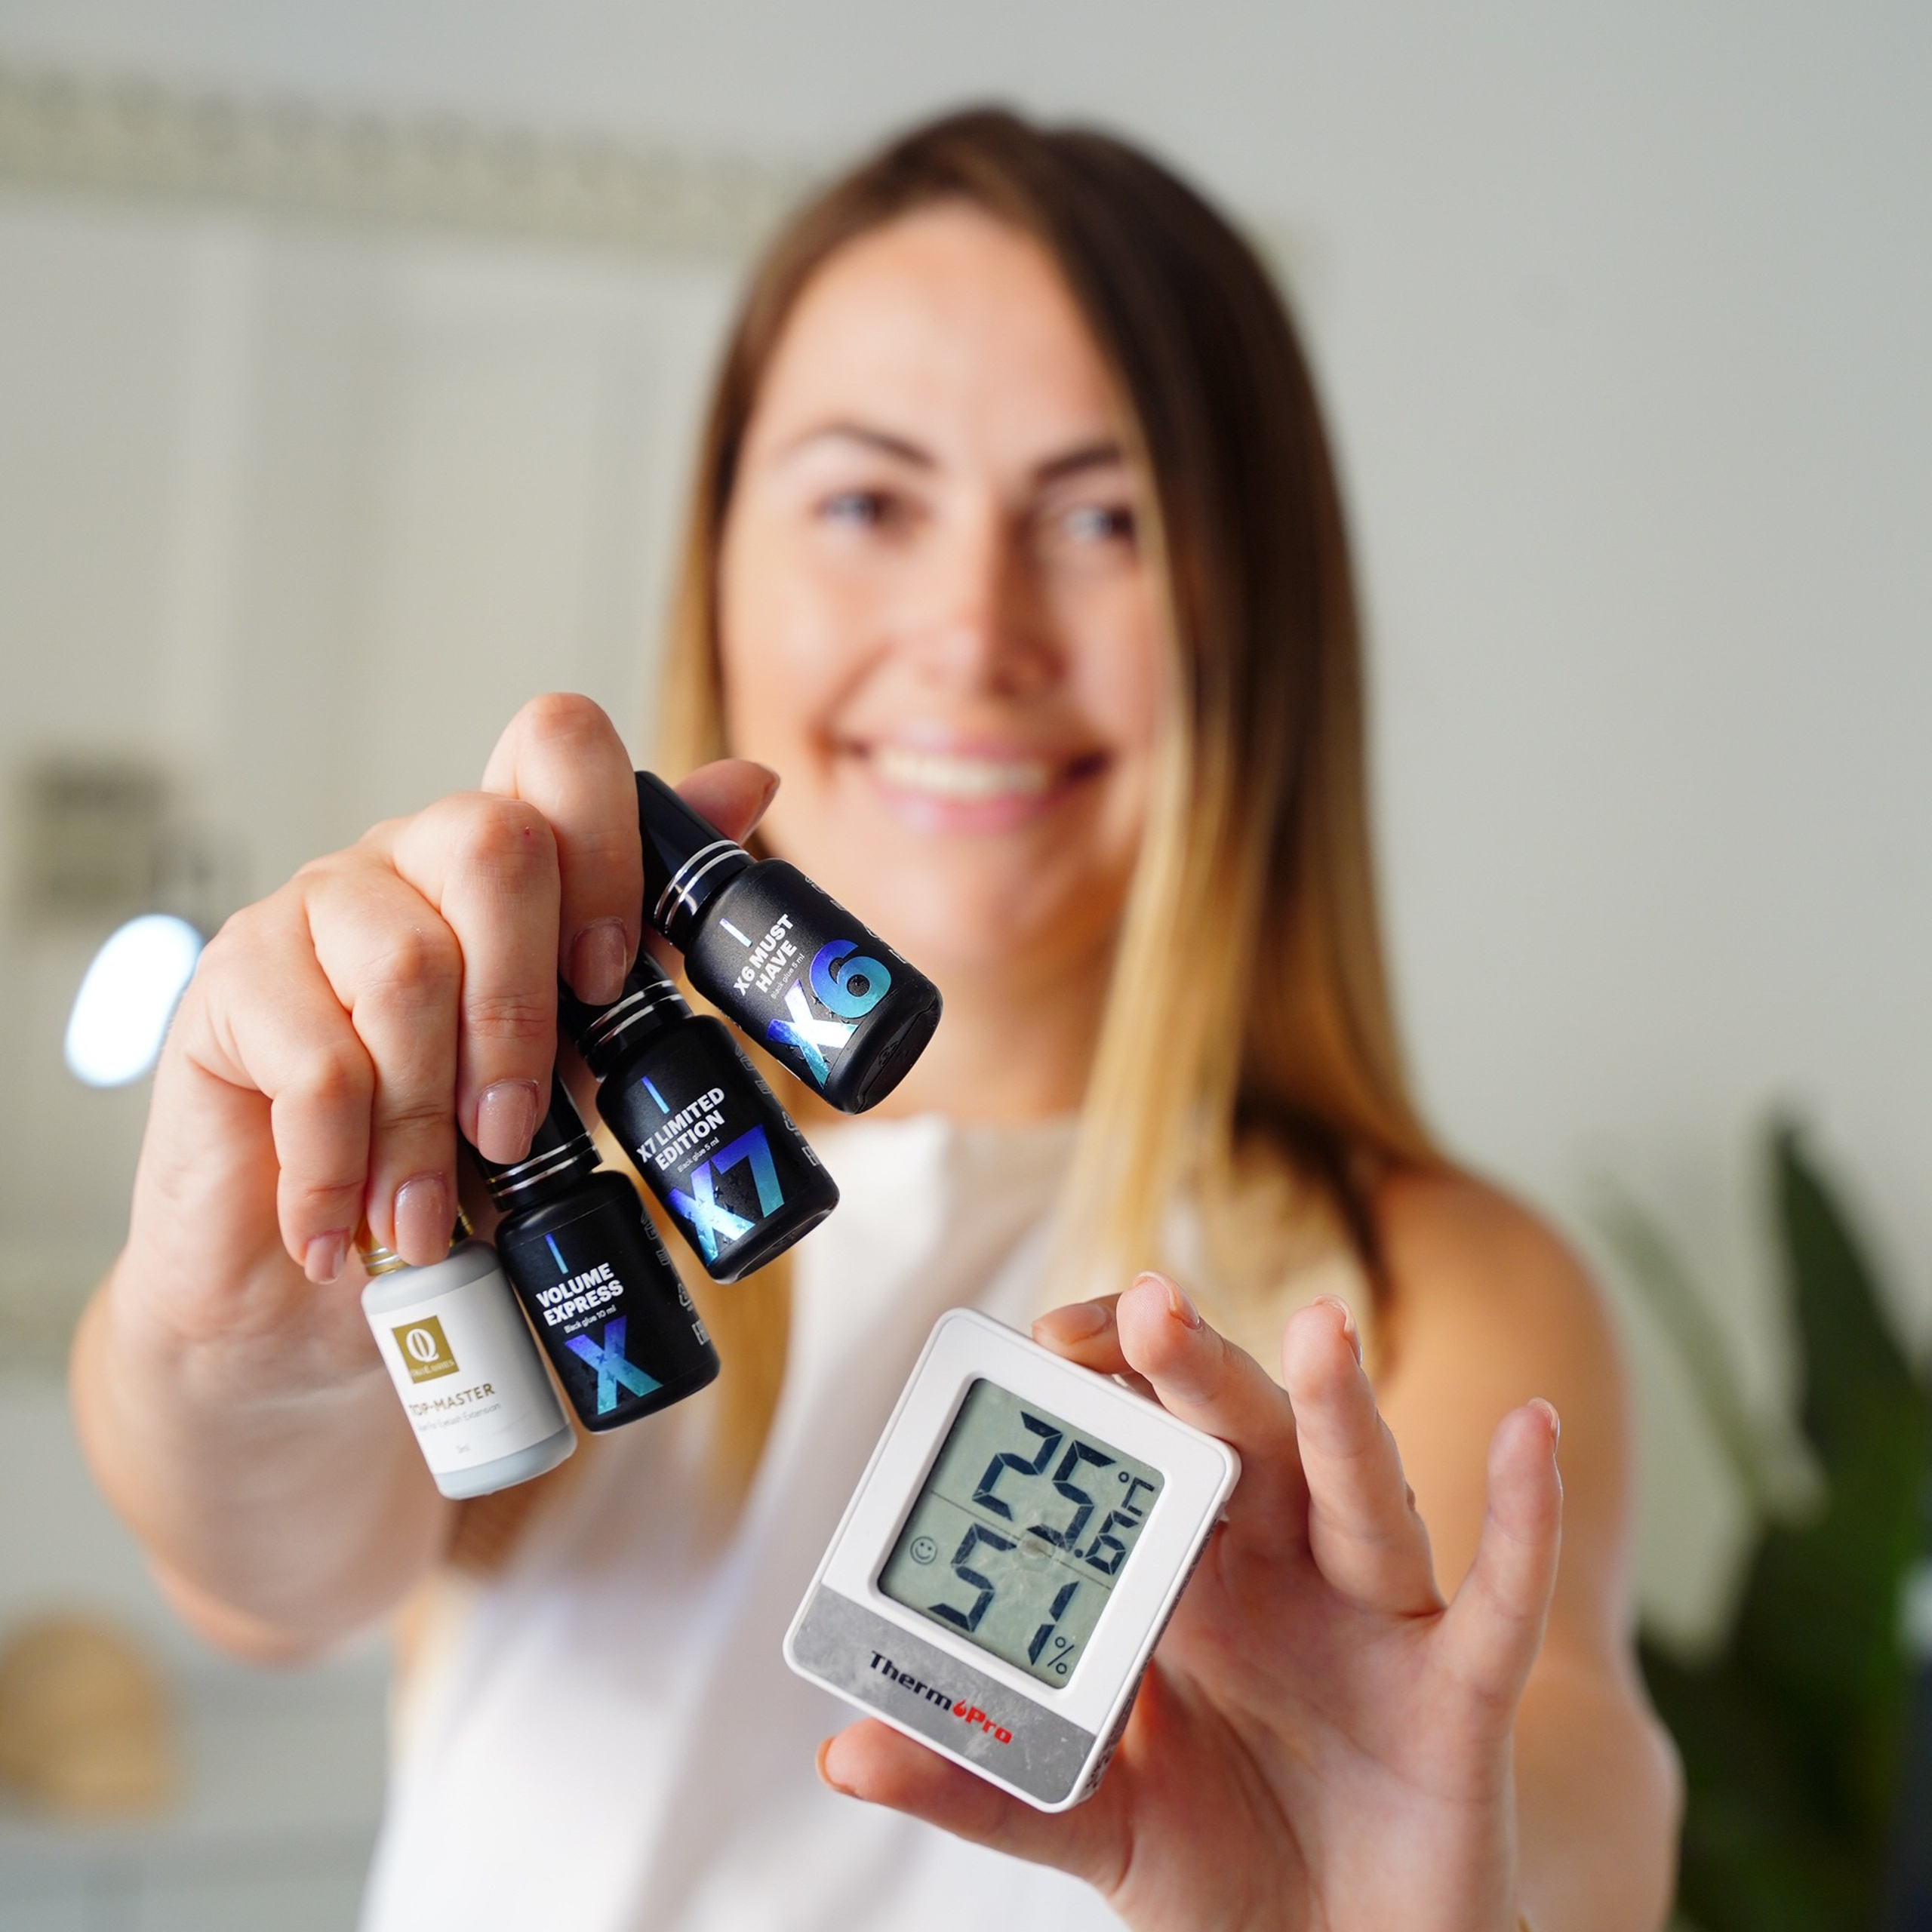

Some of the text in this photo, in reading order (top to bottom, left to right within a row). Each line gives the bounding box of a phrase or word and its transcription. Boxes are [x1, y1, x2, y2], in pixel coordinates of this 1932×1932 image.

[733, 913, 793, 996] X6 MUST
[755, 940, 798, 993] HAVE
[771, 983, 785, 1000] Black
[782, 968, 795, 984] glue
[796, 952, 805, 964] ml
[766, 939, 892, 1089] X6
[636, 1088, 725, 1163] X7 LIMITED
[654, 1109, 725, 1171] EDITION
[677, 1137, 720, 1174] Black glue 5 ml
[667, 1123, 785, 1267] X7
[535, 1262, 615, 1309] VOLUME
[543, 1279, 624, 1327] EXPRESS
[405, 1328, 439, 1363] Q
[563, 1304, 617, 1334] Black glue 10 ml
[565, 1315, 664, 1416] X
